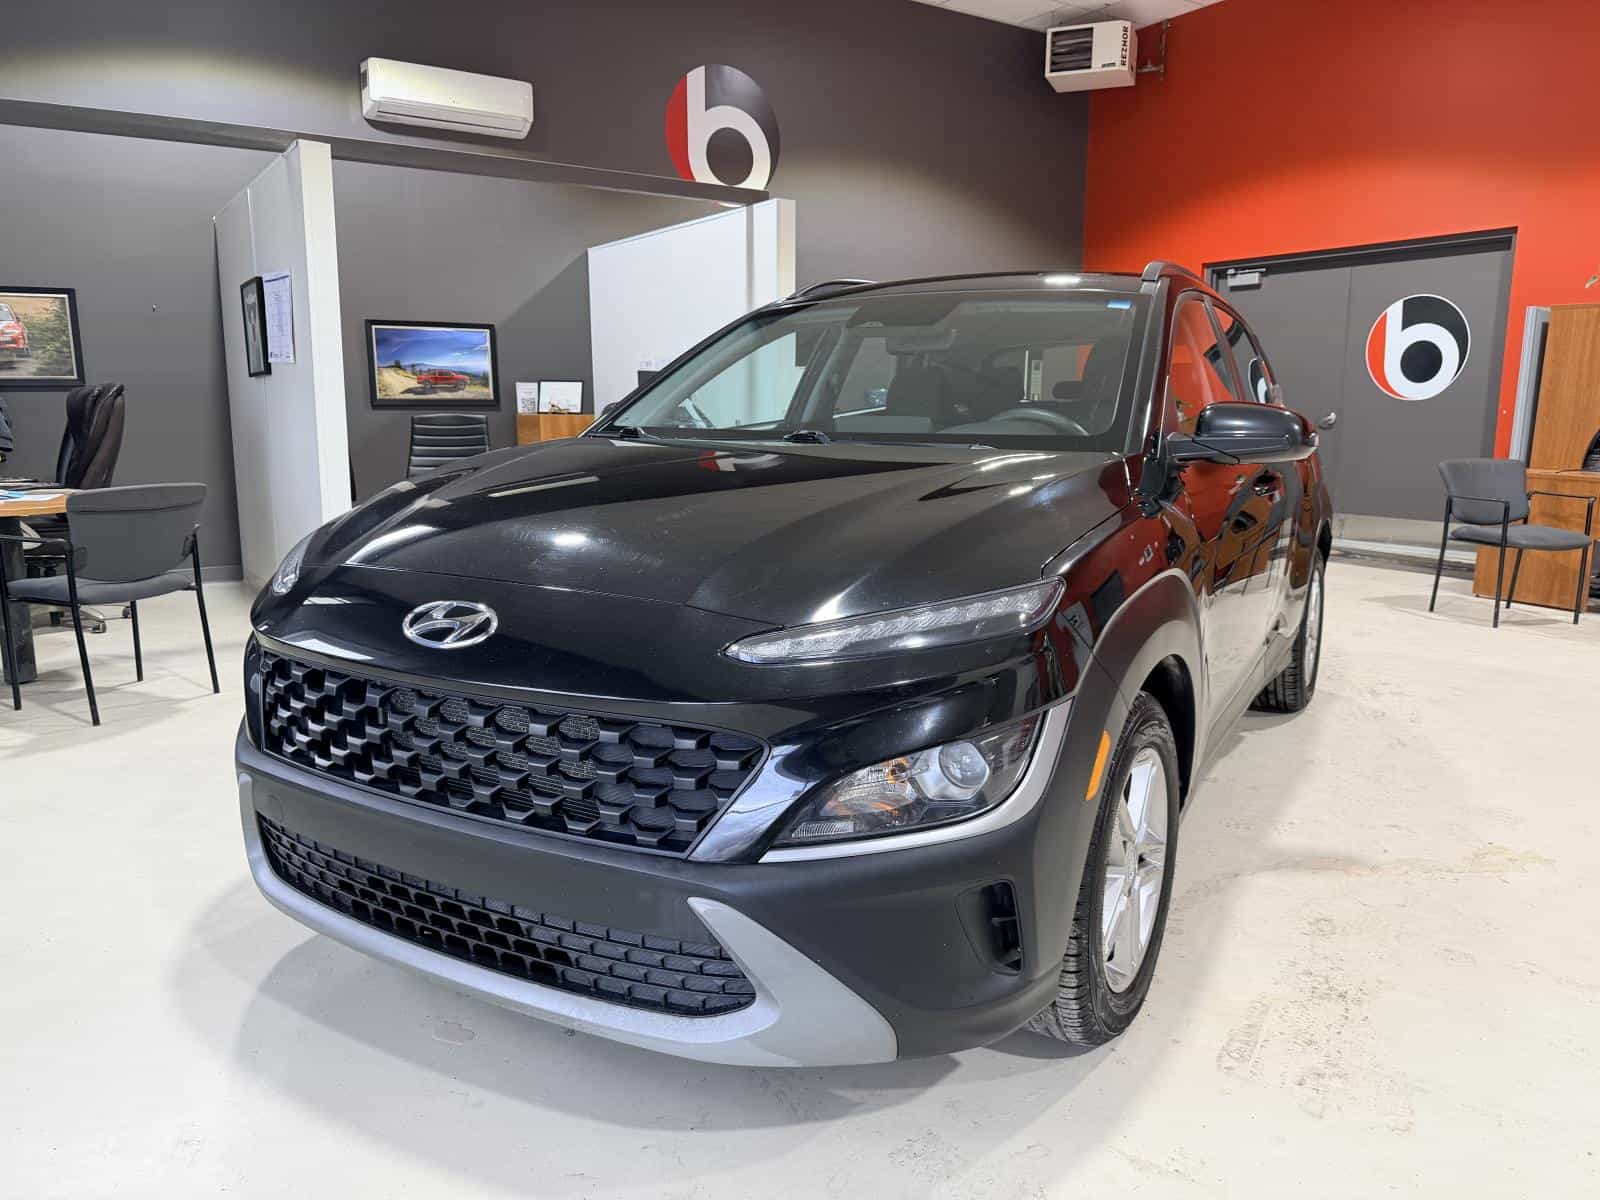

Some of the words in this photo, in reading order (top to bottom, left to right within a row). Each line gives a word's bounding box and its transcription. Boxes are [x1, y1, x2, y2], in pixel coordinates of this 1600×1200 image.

[1121, 25, 1129, 66] REZNOR
[686, 65, 771, 190] b
[1384, 299, 1460, 400] b
